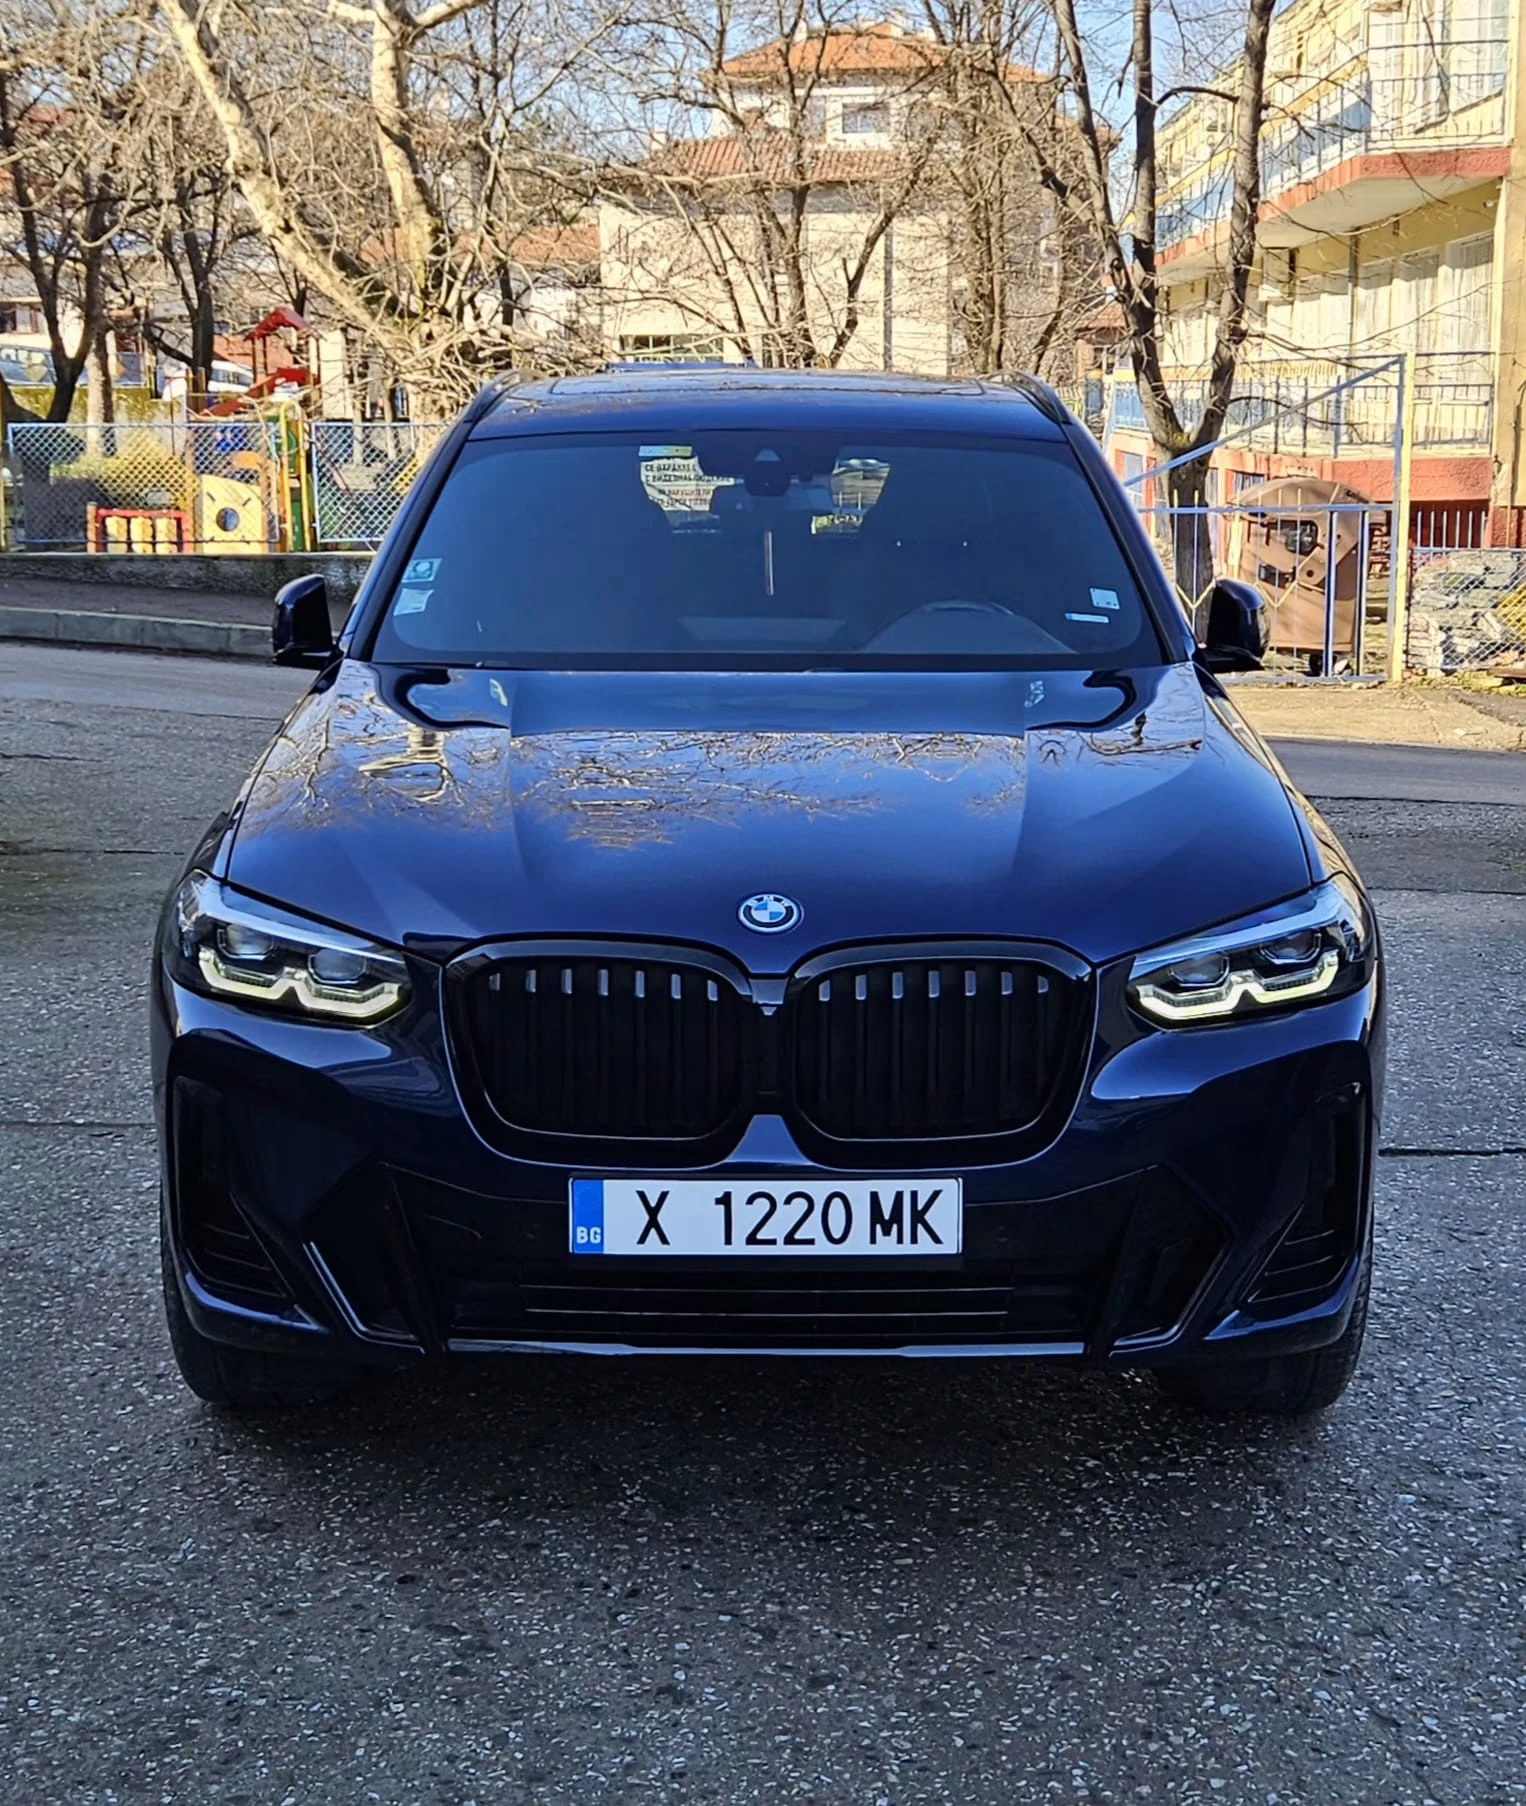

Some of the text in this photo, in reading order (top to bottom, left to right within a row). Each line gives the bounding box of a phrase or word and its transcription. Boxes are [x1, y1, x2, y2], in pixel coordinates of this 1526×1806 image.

[576, 1226, 601, 1244] BG
[636, 1190, 943, 1245] X 1220 MK
